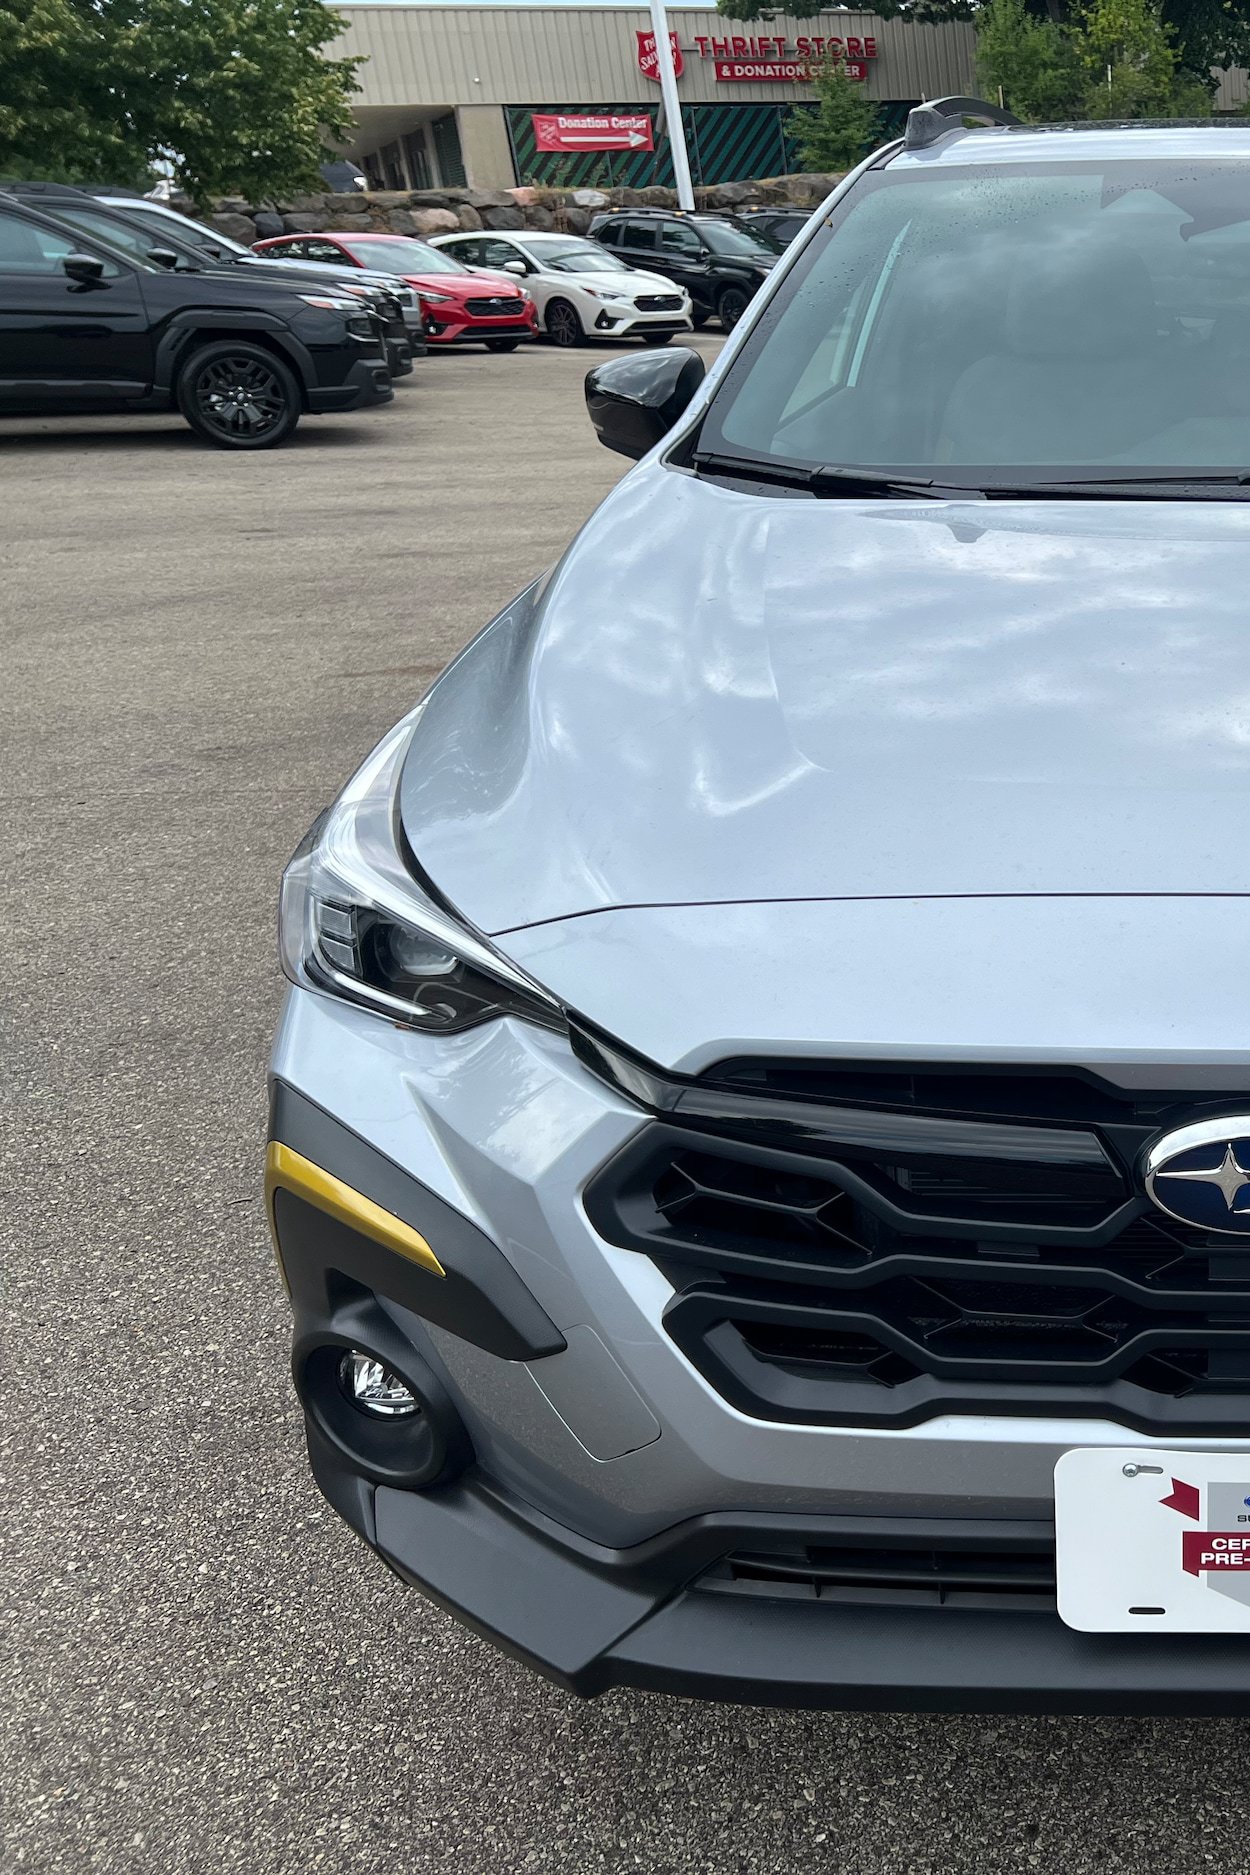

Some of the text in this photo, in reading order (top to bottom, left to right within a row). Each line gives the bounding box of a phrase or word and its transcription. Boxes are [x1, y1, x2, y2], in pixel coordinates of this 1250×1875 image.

[694, 36, 877, 59] THRIFT STORE
[721, 65, 731, 77] &
[735, 65, 805, 77] DONATION
[557, 117, 647, 129] Donation Center
